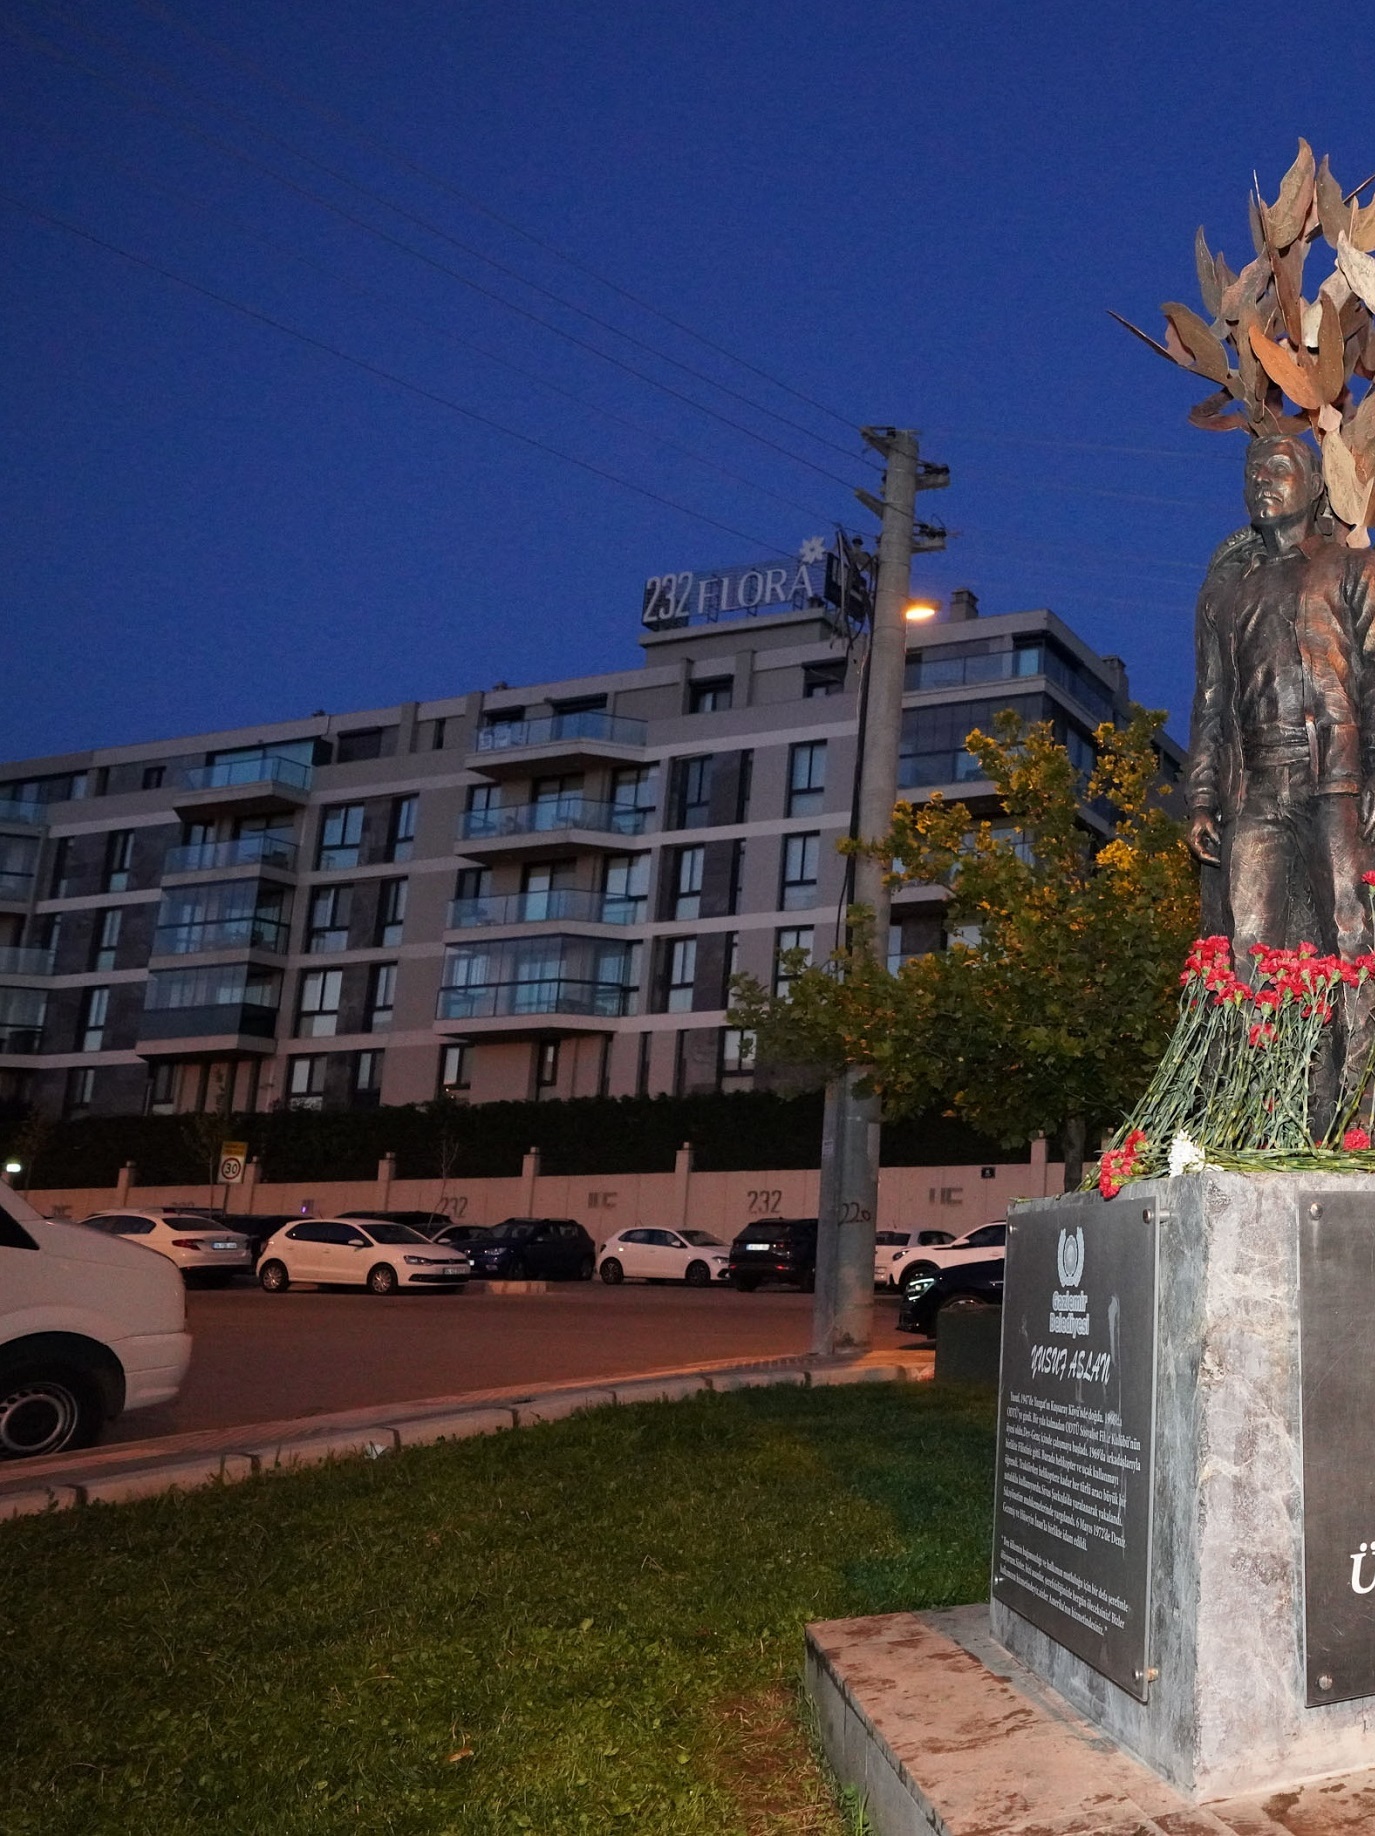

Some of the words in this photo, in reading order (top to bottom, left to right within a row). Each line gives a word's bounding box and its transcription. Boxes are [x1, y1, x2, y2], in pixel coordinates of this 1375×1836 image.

[643, 571, 694, 623] 232
[697, 565, 814, 615] FLORA
[225, 1163, 238, 1174] 30
[747, 1190, 782, 1214] 232
[1052, 1290, 1088, 1312] Gaziemir
[1049, 1312, 1090, 1339] Belediyesi
[1031, 1344, 1067, 1381] YUSUF
[1068, 1349, 1111, 1386] ASLAN
